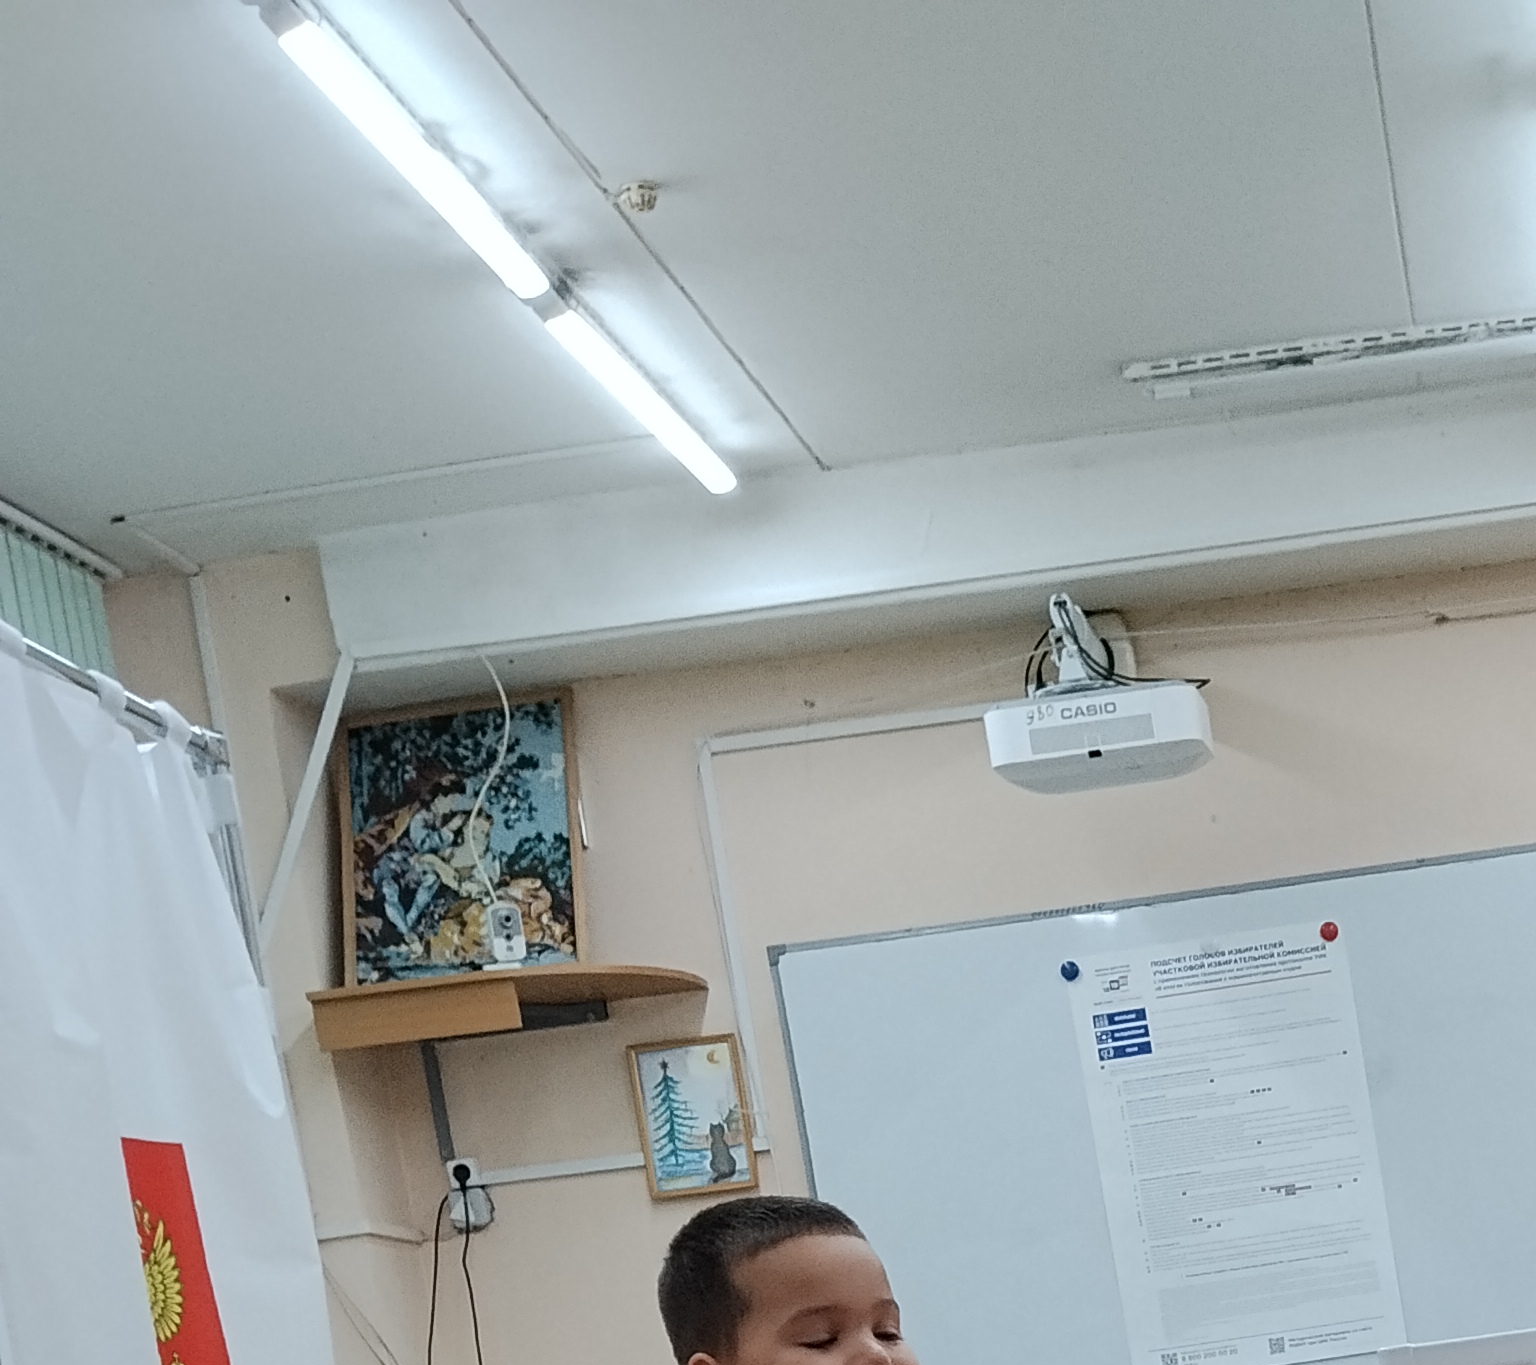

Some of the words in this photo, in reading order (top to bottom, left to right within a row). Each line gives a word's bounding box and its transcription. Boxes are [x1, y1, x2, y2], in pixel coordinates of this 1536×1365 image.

[1060, 702, 1117, 720] CASIO
[1228, 940, 1284, 956] ИЗБИРАТЕЛЕЙ
[1152, 962, 1205, 977] УЧАСТКОВОЙ
[1207, 952, 1275, 969] ИЗБИРАТЕЛЬНОЙ
[1277, 943, 1327, 958] КОМИССИЕЙ
